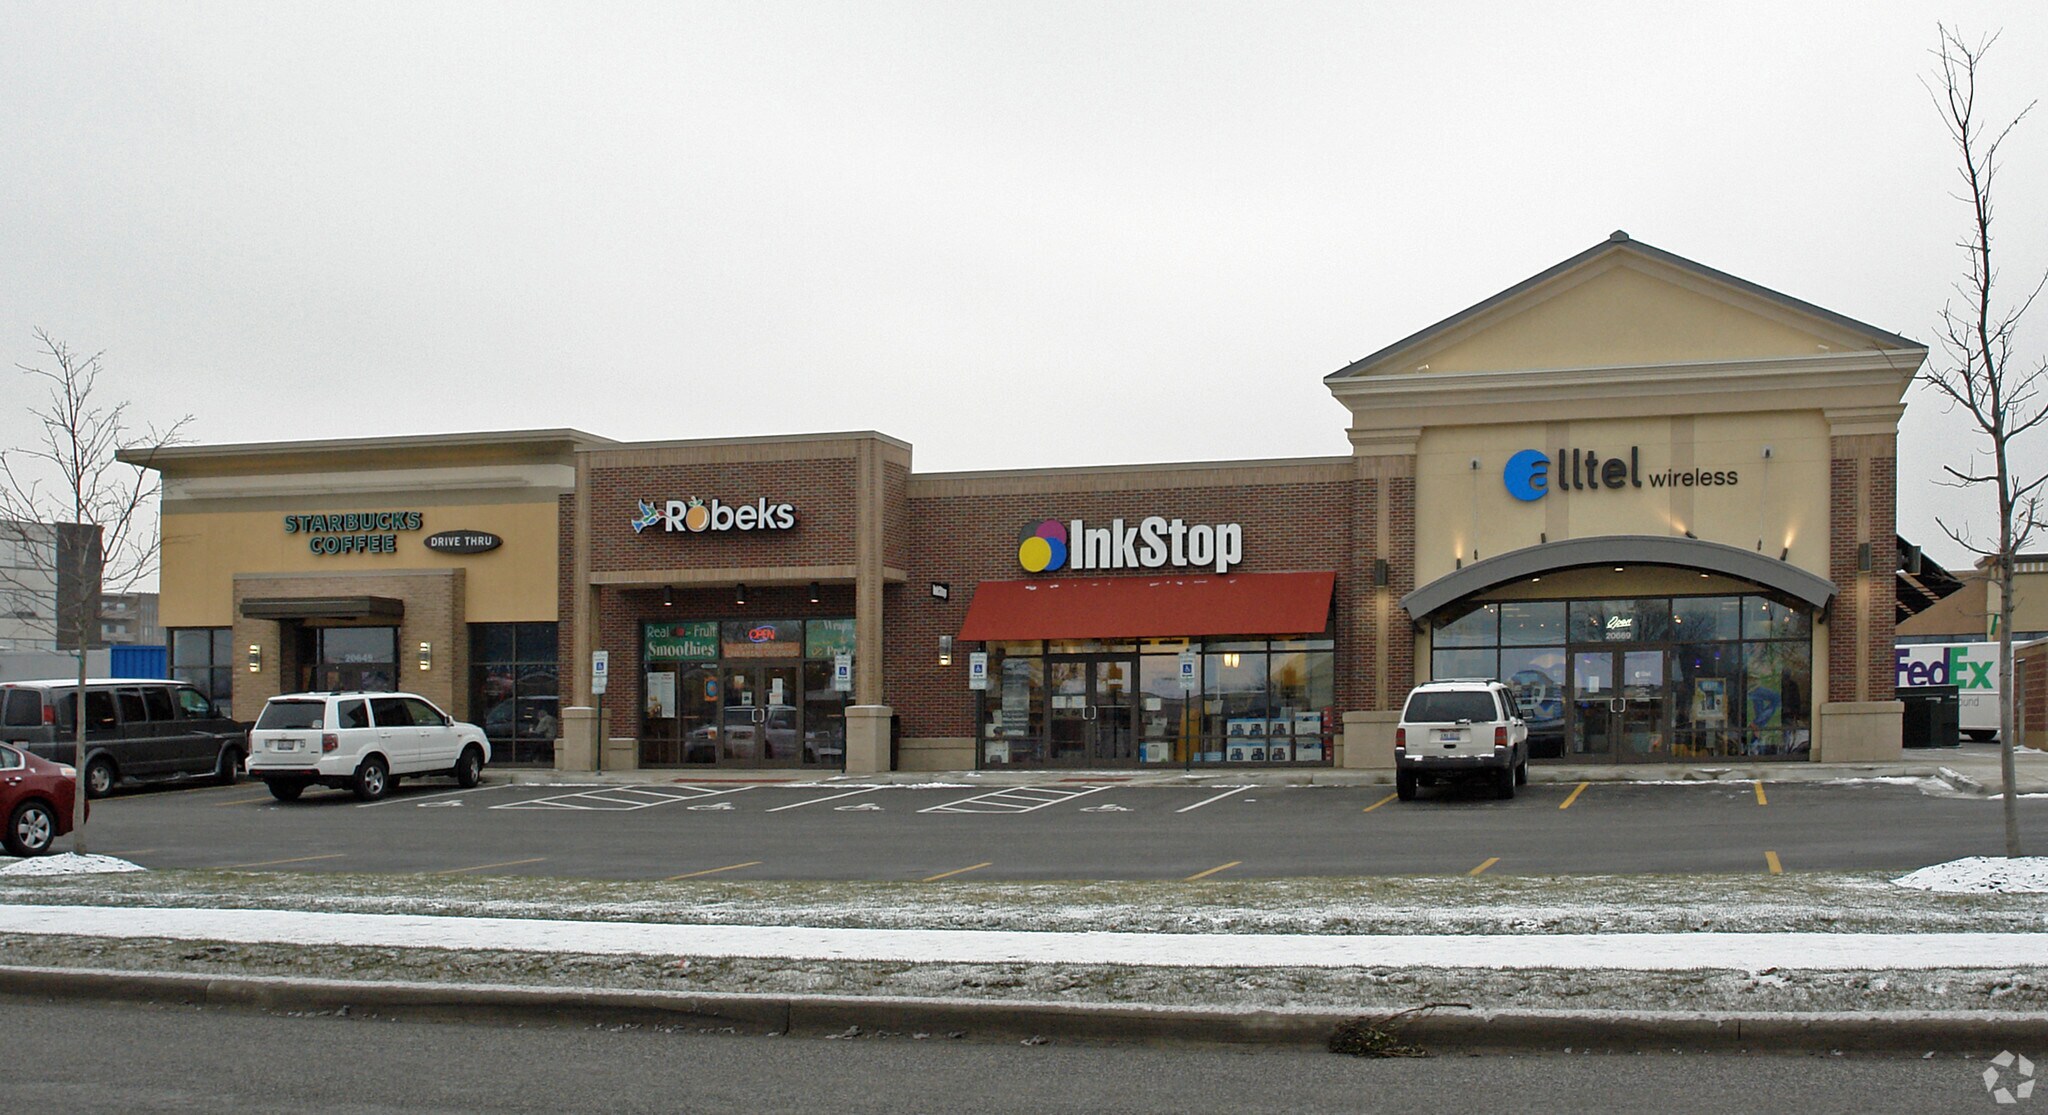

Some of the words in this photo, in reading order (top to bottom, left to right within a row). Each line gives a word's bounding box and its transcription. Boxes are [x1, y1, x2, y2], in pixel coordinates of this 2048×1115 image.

[1503, 446, 1642, 502] alltel
[1649, 468, 1738, 488] wireless
[284, 511, 422, 533] STARBUCKS
[665, 497, 795, 533] Robeks
[309, 534, 397, 555] COFFEE
[431, 537, 460, 547] DRIVE
[465, 536, 492, 546] THRU
[1070, 516, 1242, 574] InkStop
[647, 626, 670, 638] Real
[694, 624, 718, 637] Fruit
[1606, 616, 1632, 629] Open
[749, 628, 775, 640] OPEN
[648, 641, 715, 656] Smoothies
[1895, 647, 1994, 689] FedEx
